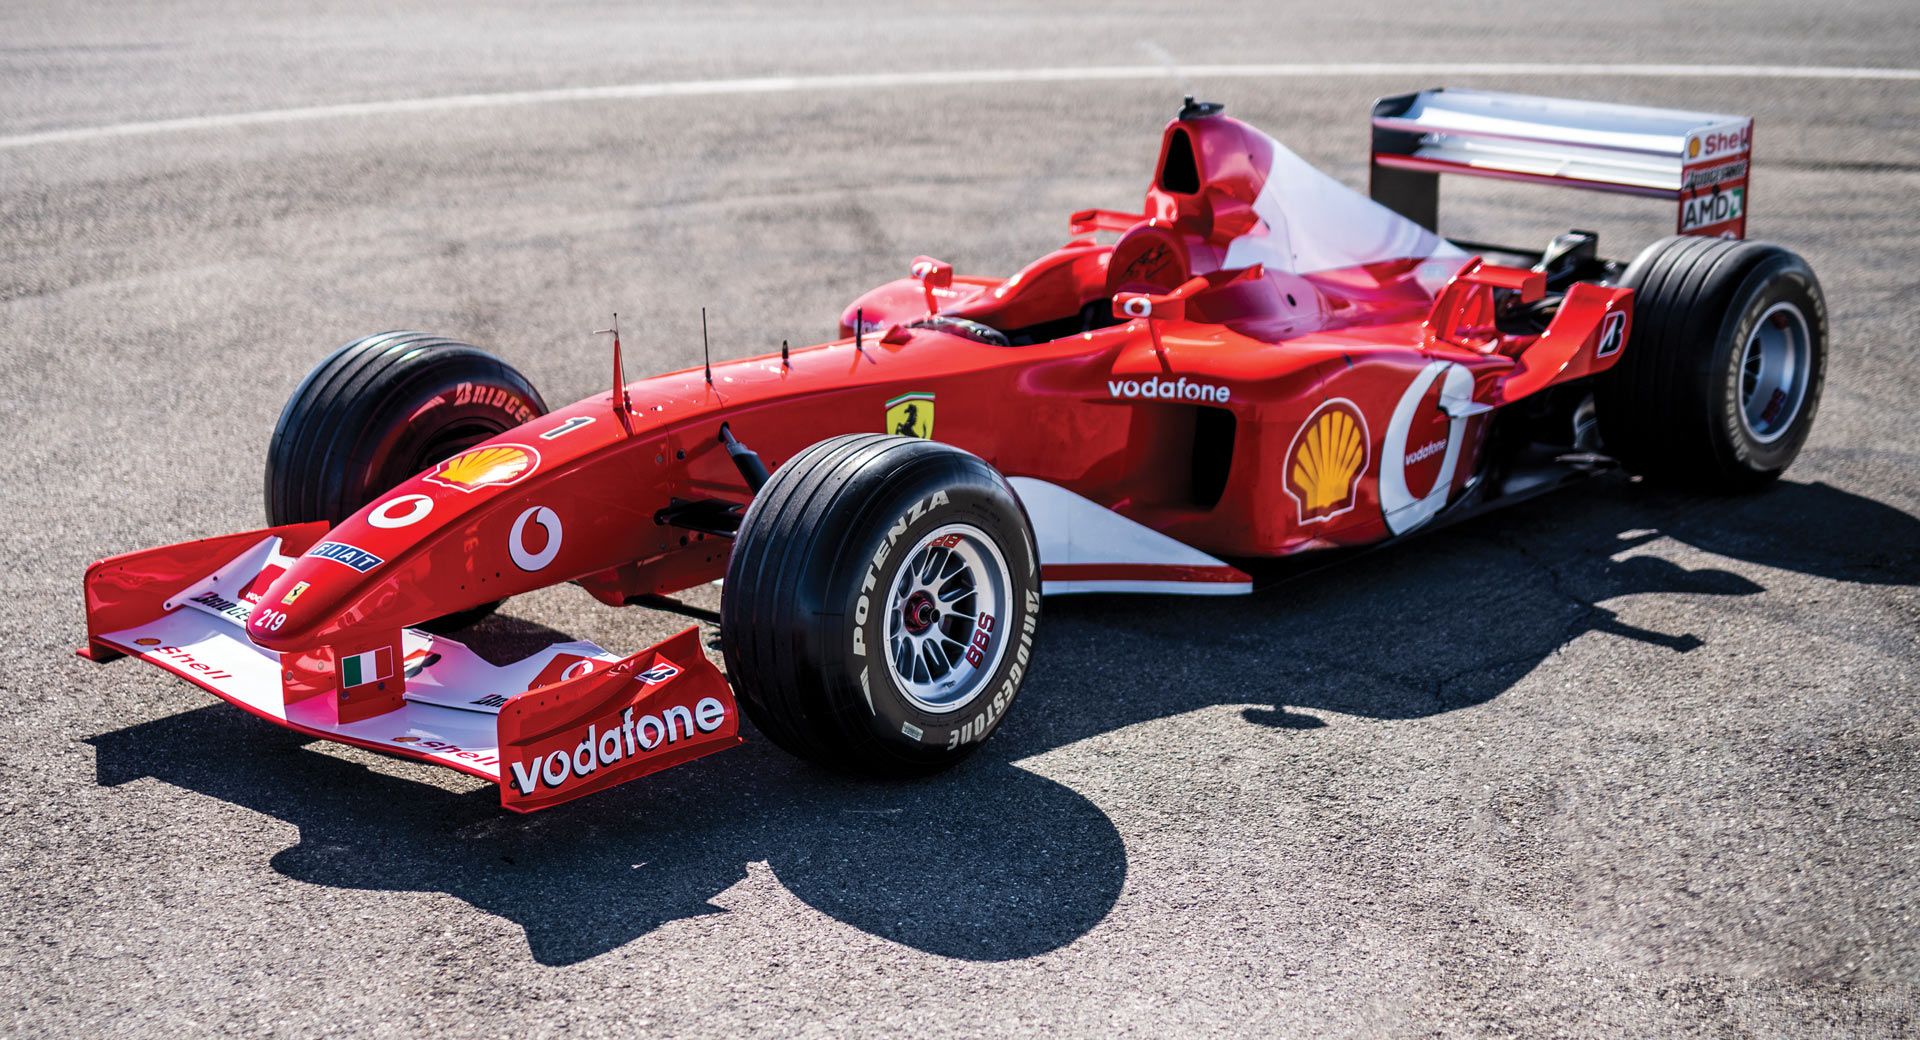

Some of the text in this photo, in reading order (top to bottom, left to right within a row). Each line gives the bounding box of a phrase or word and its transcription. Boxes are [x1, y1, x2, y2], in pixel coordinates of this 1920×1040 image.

[1684, 195, 1729, 229] AMD
[1107, 376, 1231, 402] vodafone
[538, 416, 597, 440] 1
[1405, 439, 1447, 466] vodafone
[311, 543, 378, 568] FIAT
[853, 489, 950, 656] POTENZA
[254, 608, 287, 631] 219
[965, 611, 995, 669] BBS
[153, 646, 232, 679] Shell
[946, 588, 1041, 751] BRIDGESTONE
[415, 741, 500, 766] Shell
[511, 697, 725, 794] vodafone
